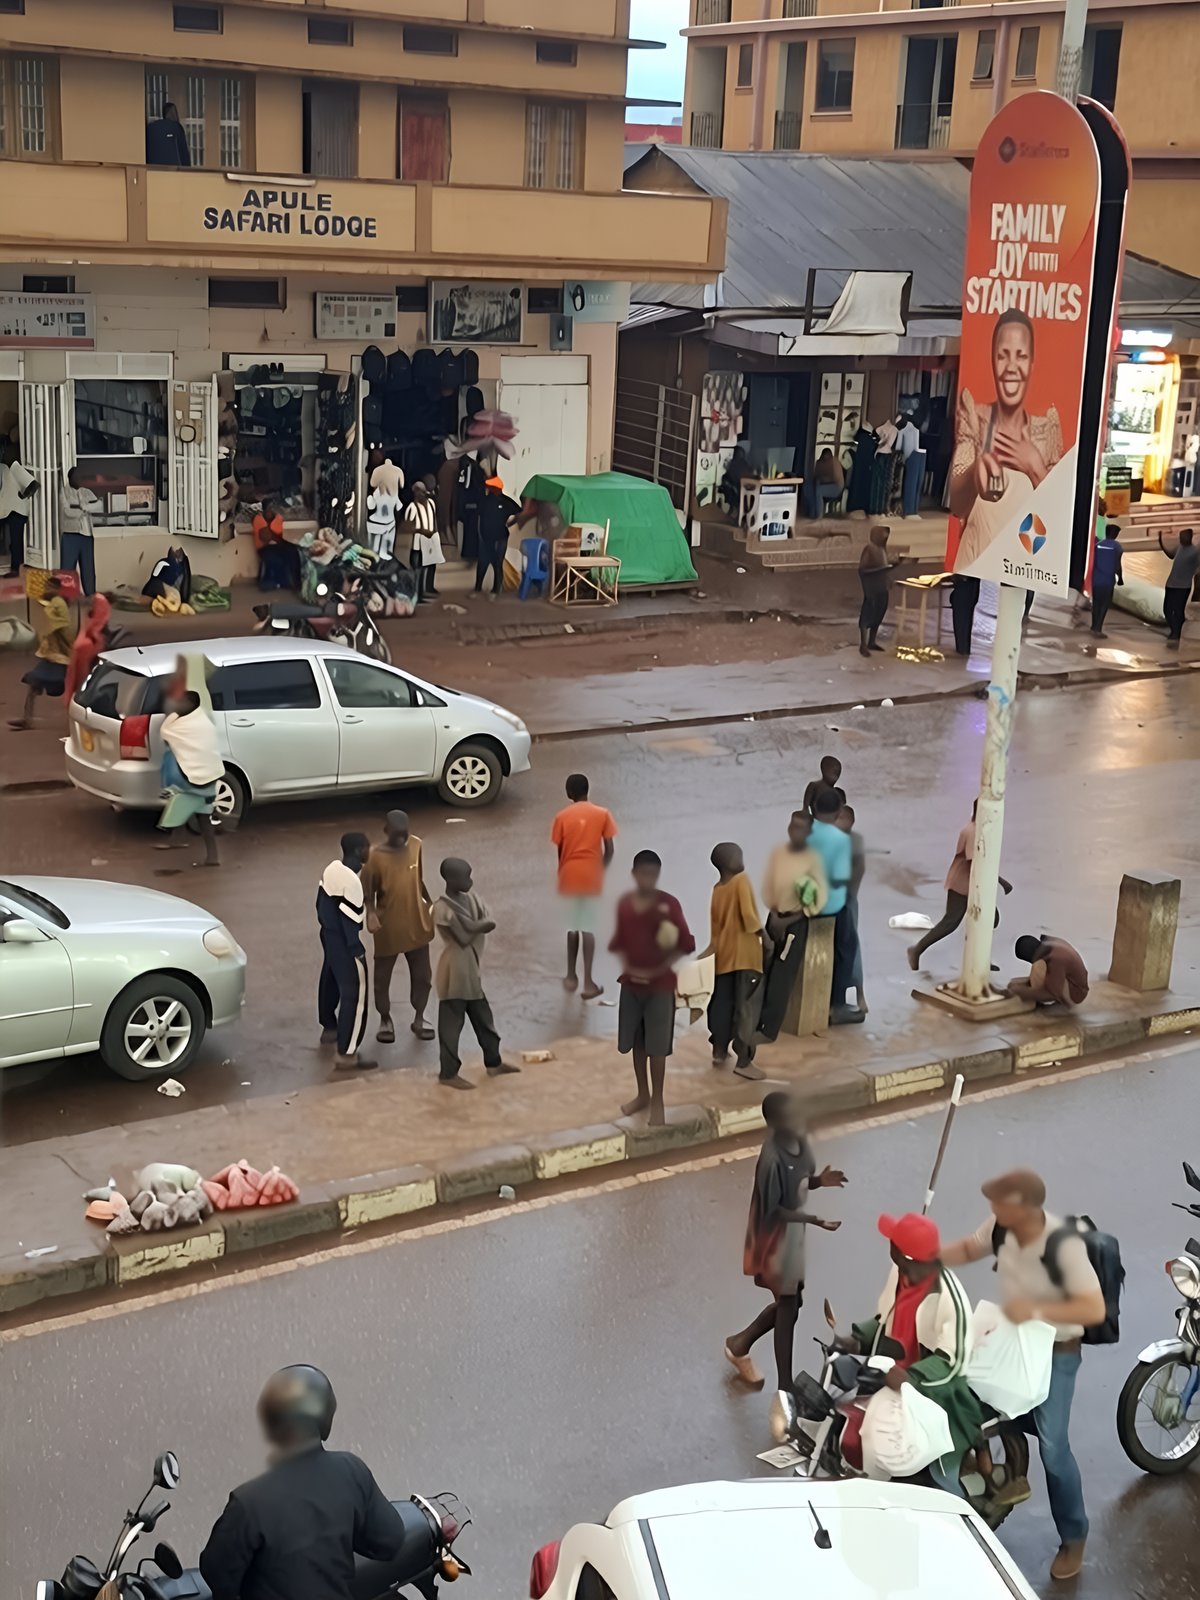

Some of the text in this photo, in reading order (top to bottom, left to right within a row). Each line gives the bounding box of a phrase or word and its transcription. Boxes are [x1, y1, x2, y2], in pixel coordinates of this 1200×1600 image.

[243, 189, 332, 211] APULE
[203, 207, 377, 238] SAFARI LODGE
[991, 203, 1067, 243] FAMILY
[989, 242, 1028, 279] JOY
[966, 276, 1082, 321] STARTIMES
